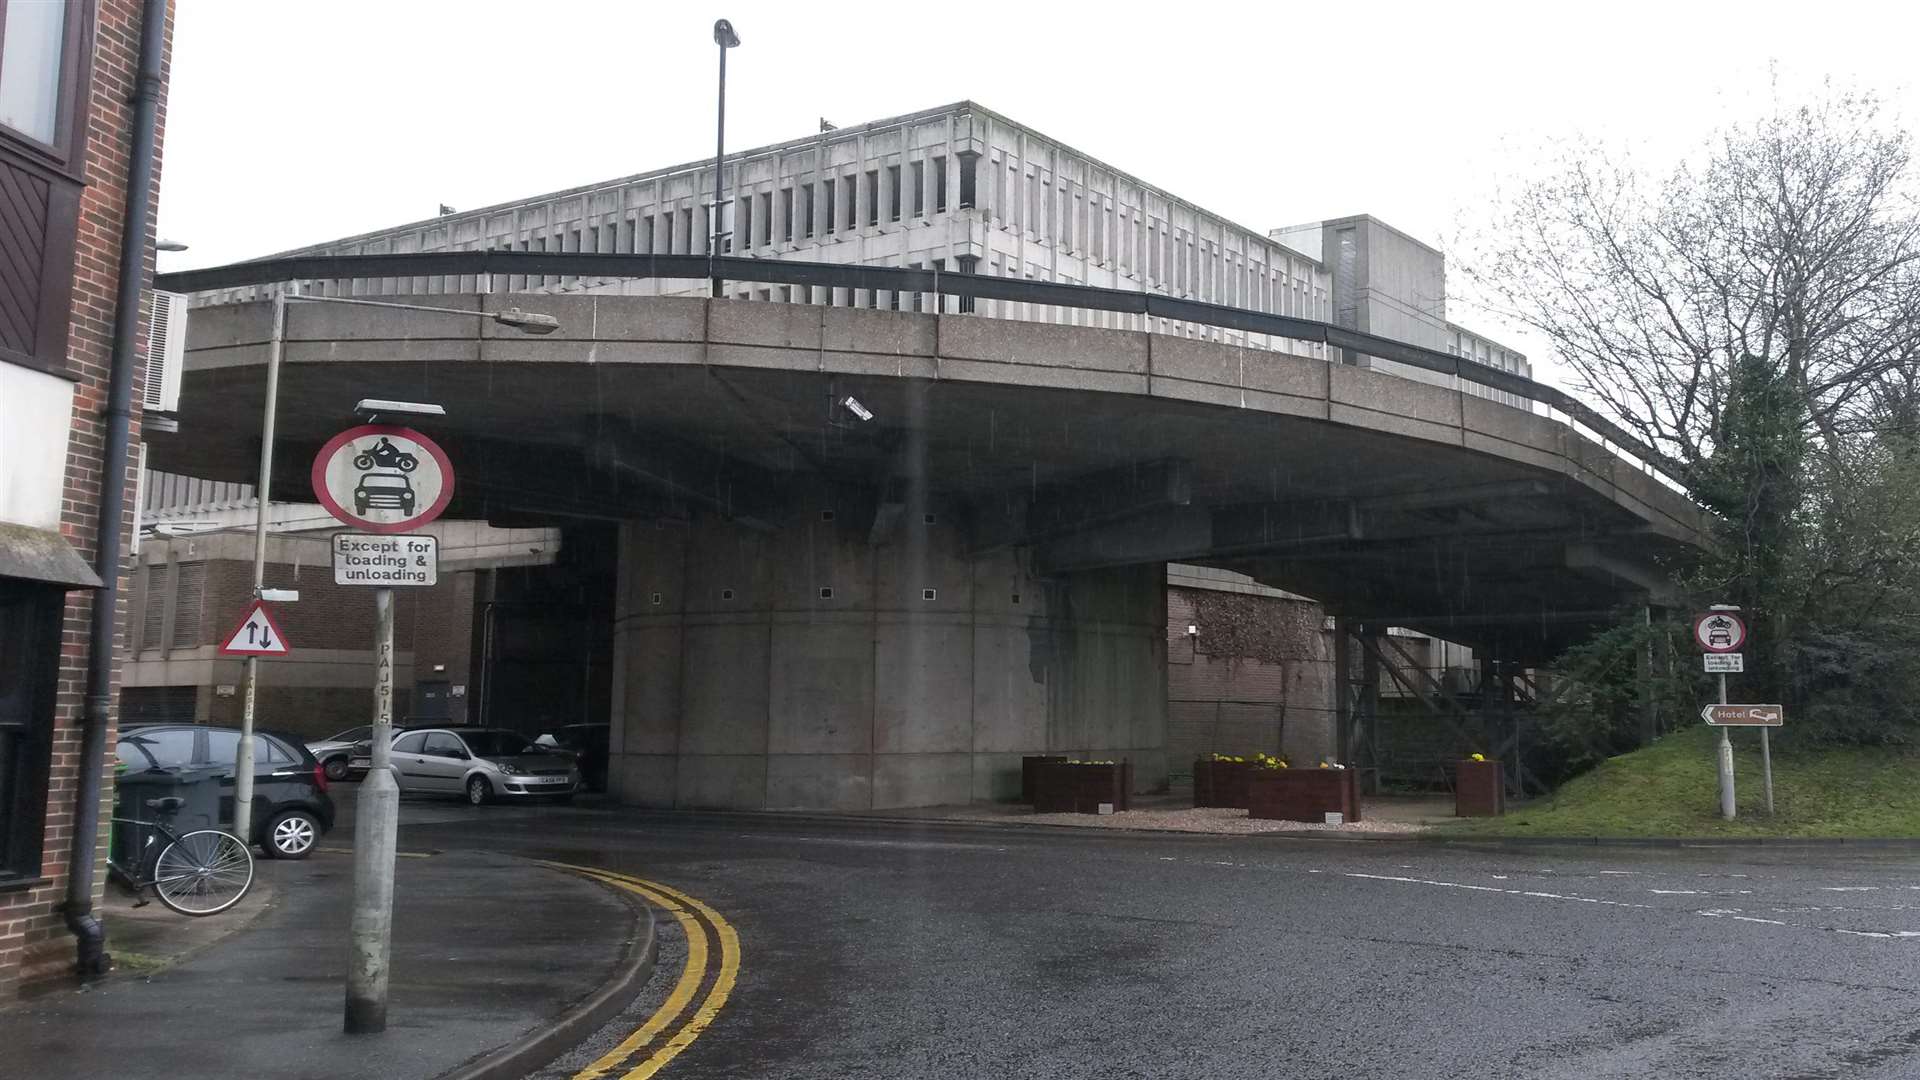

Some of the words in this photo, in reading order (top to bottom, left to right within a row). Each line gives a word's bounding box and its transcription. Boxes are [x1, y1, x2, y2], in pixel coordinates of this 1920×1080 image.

[340, 540, 398, 553] Except
[407, 541, 430, 552] for
[345, 554, 407, 568] loading
[416, 555, 426, 566] &
[346, 569, 426, 582] unloading
